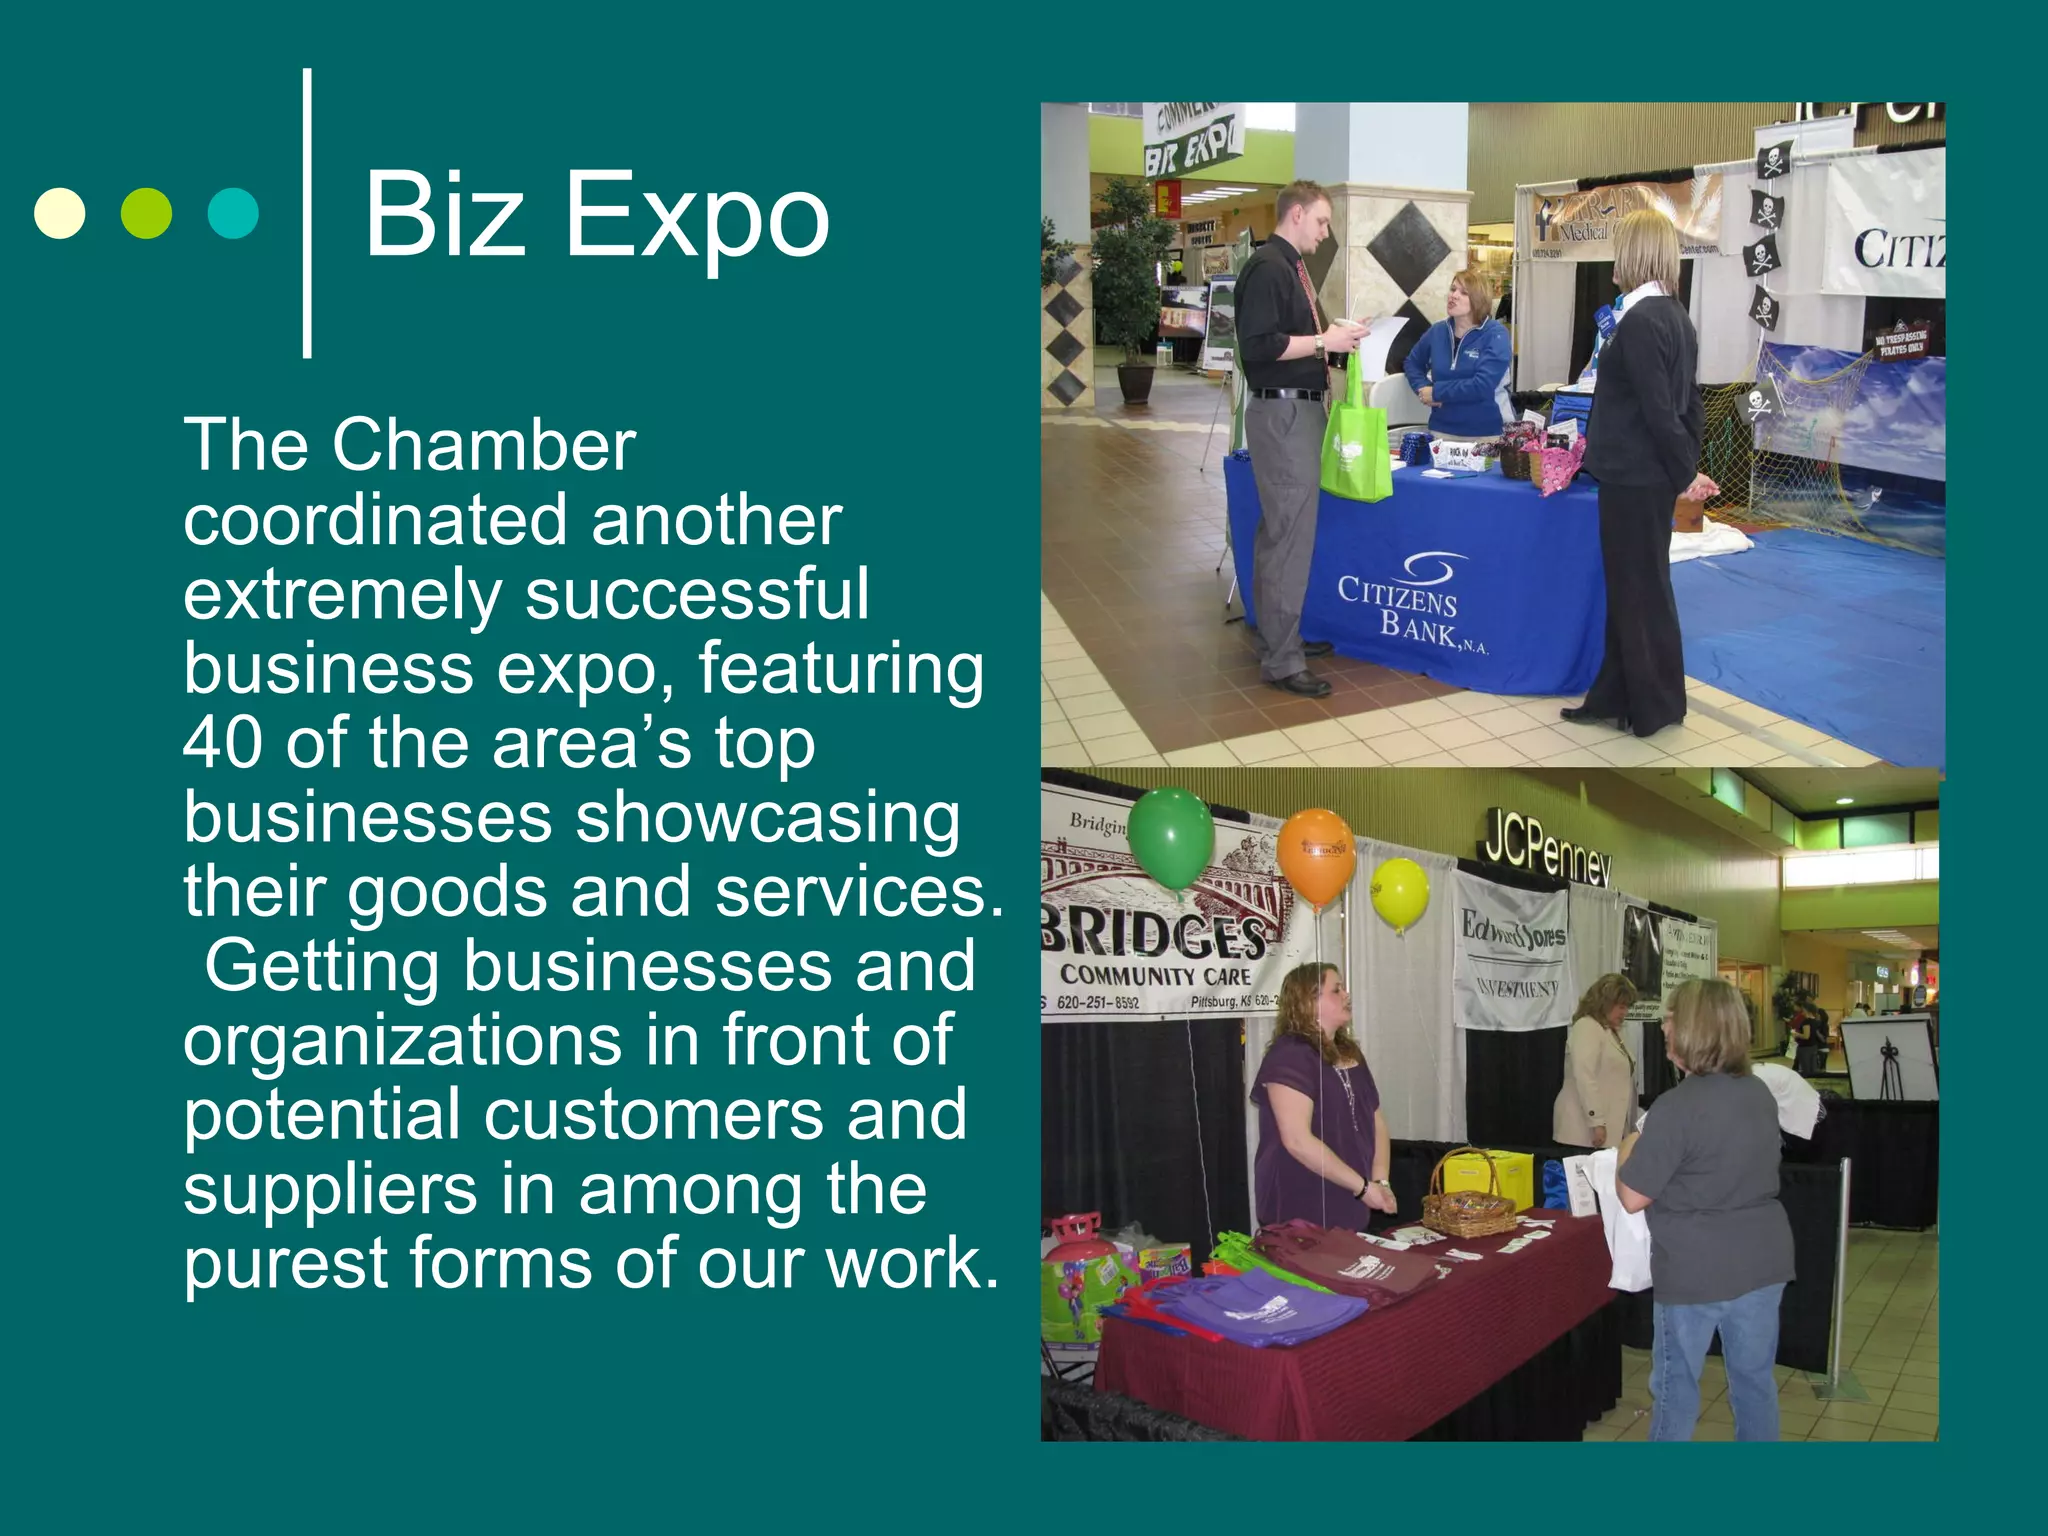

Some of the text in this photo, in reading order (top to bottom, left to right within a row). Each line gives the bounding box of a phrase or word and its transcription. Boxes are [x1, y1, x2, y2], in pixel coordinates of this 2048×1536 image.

[1561, 222, 1608, 242] Medical
[1876, 330, 1927, 346] NO TRESPASSING
[1881, 342, 1924, 356] PIRATES ONLY
[1338, 575, 1457, 618] CITIZENS
[1070, 811, 1129, 840] Bridgin
[1486, 808, 1612, 888] JCPenney
[1041, 902, 1266, 960] BRIDGES
[1462, 907, 1566, 951] Edward Jones
[1060, 963, 1252, 987] COMMUNITY CARE
[1057, 995, 1140, 1009] 620-251-8592
[1191, 996, 1238, 1009] Pittsburg,
[1241, 995, 1251, 1006] KS
